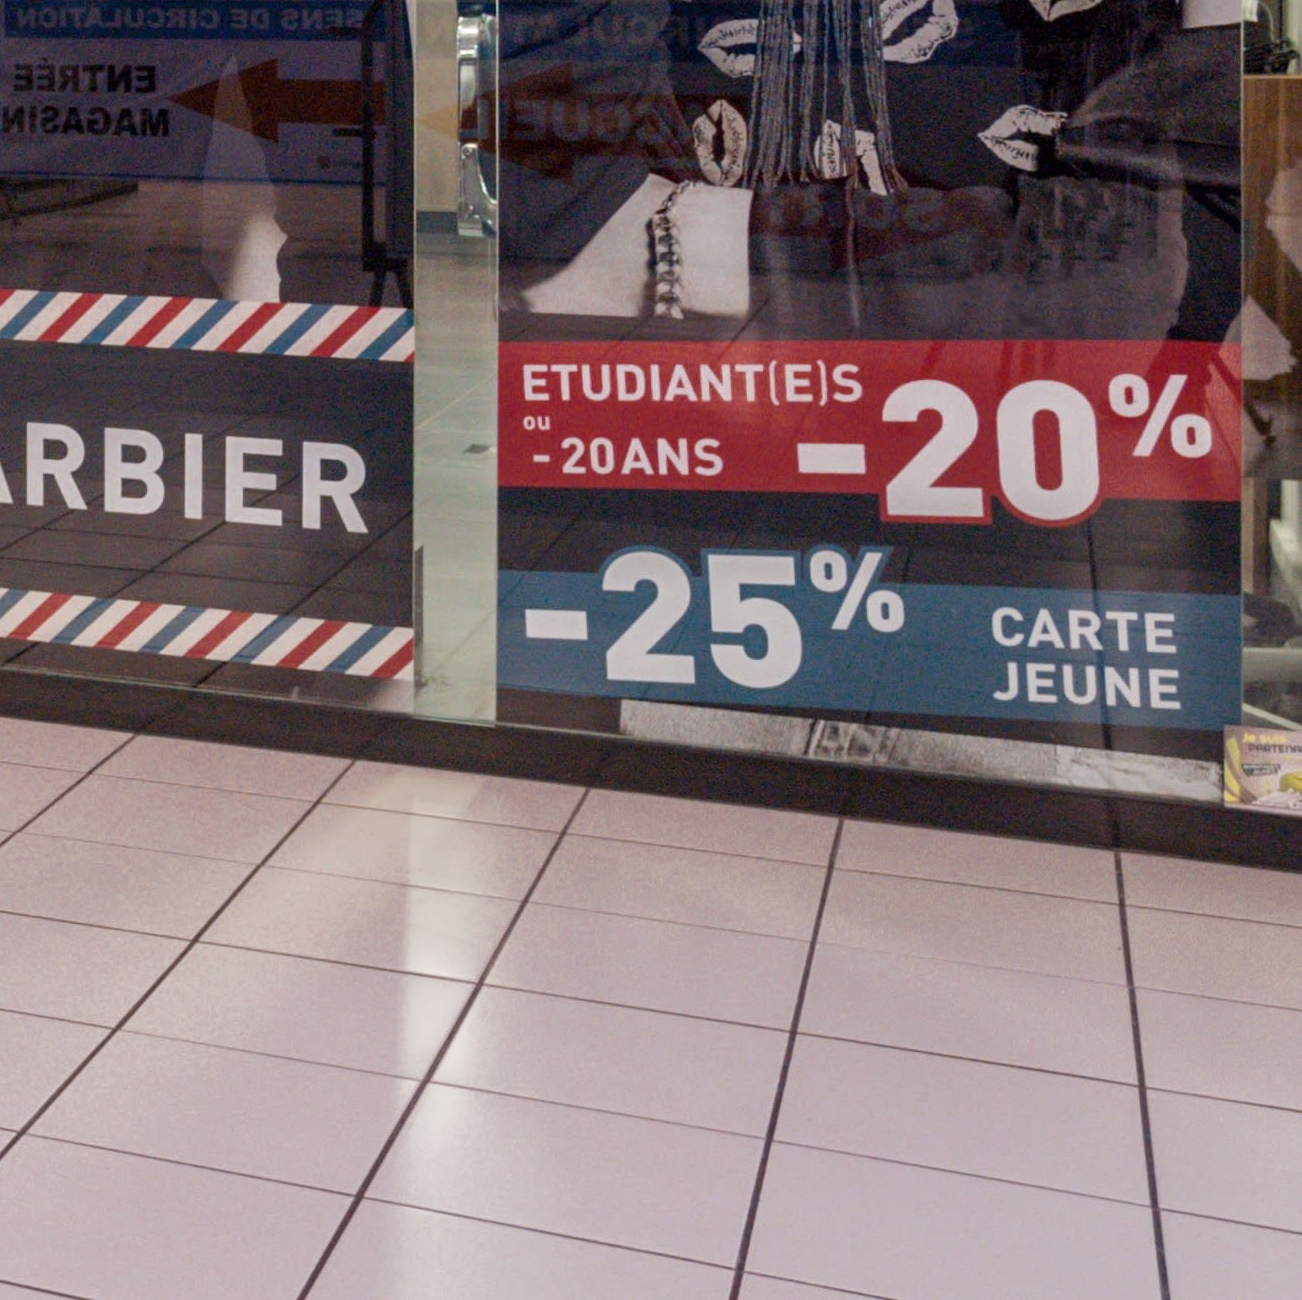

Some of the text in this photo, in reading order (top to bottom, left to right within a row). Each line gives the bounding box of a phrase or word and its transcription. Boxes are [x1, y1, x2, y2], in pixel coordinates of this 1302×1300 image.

[522, 362, 864, 408] ETUDIANT(E)S
[523, 414, 551, 432] ou
[797, 373, 1213, 522] -20%
[525, 550, 905, 689] -25%
[992, 606, 1177, 655] CARTE
[992, 662, 1182, 710] JEUNE
